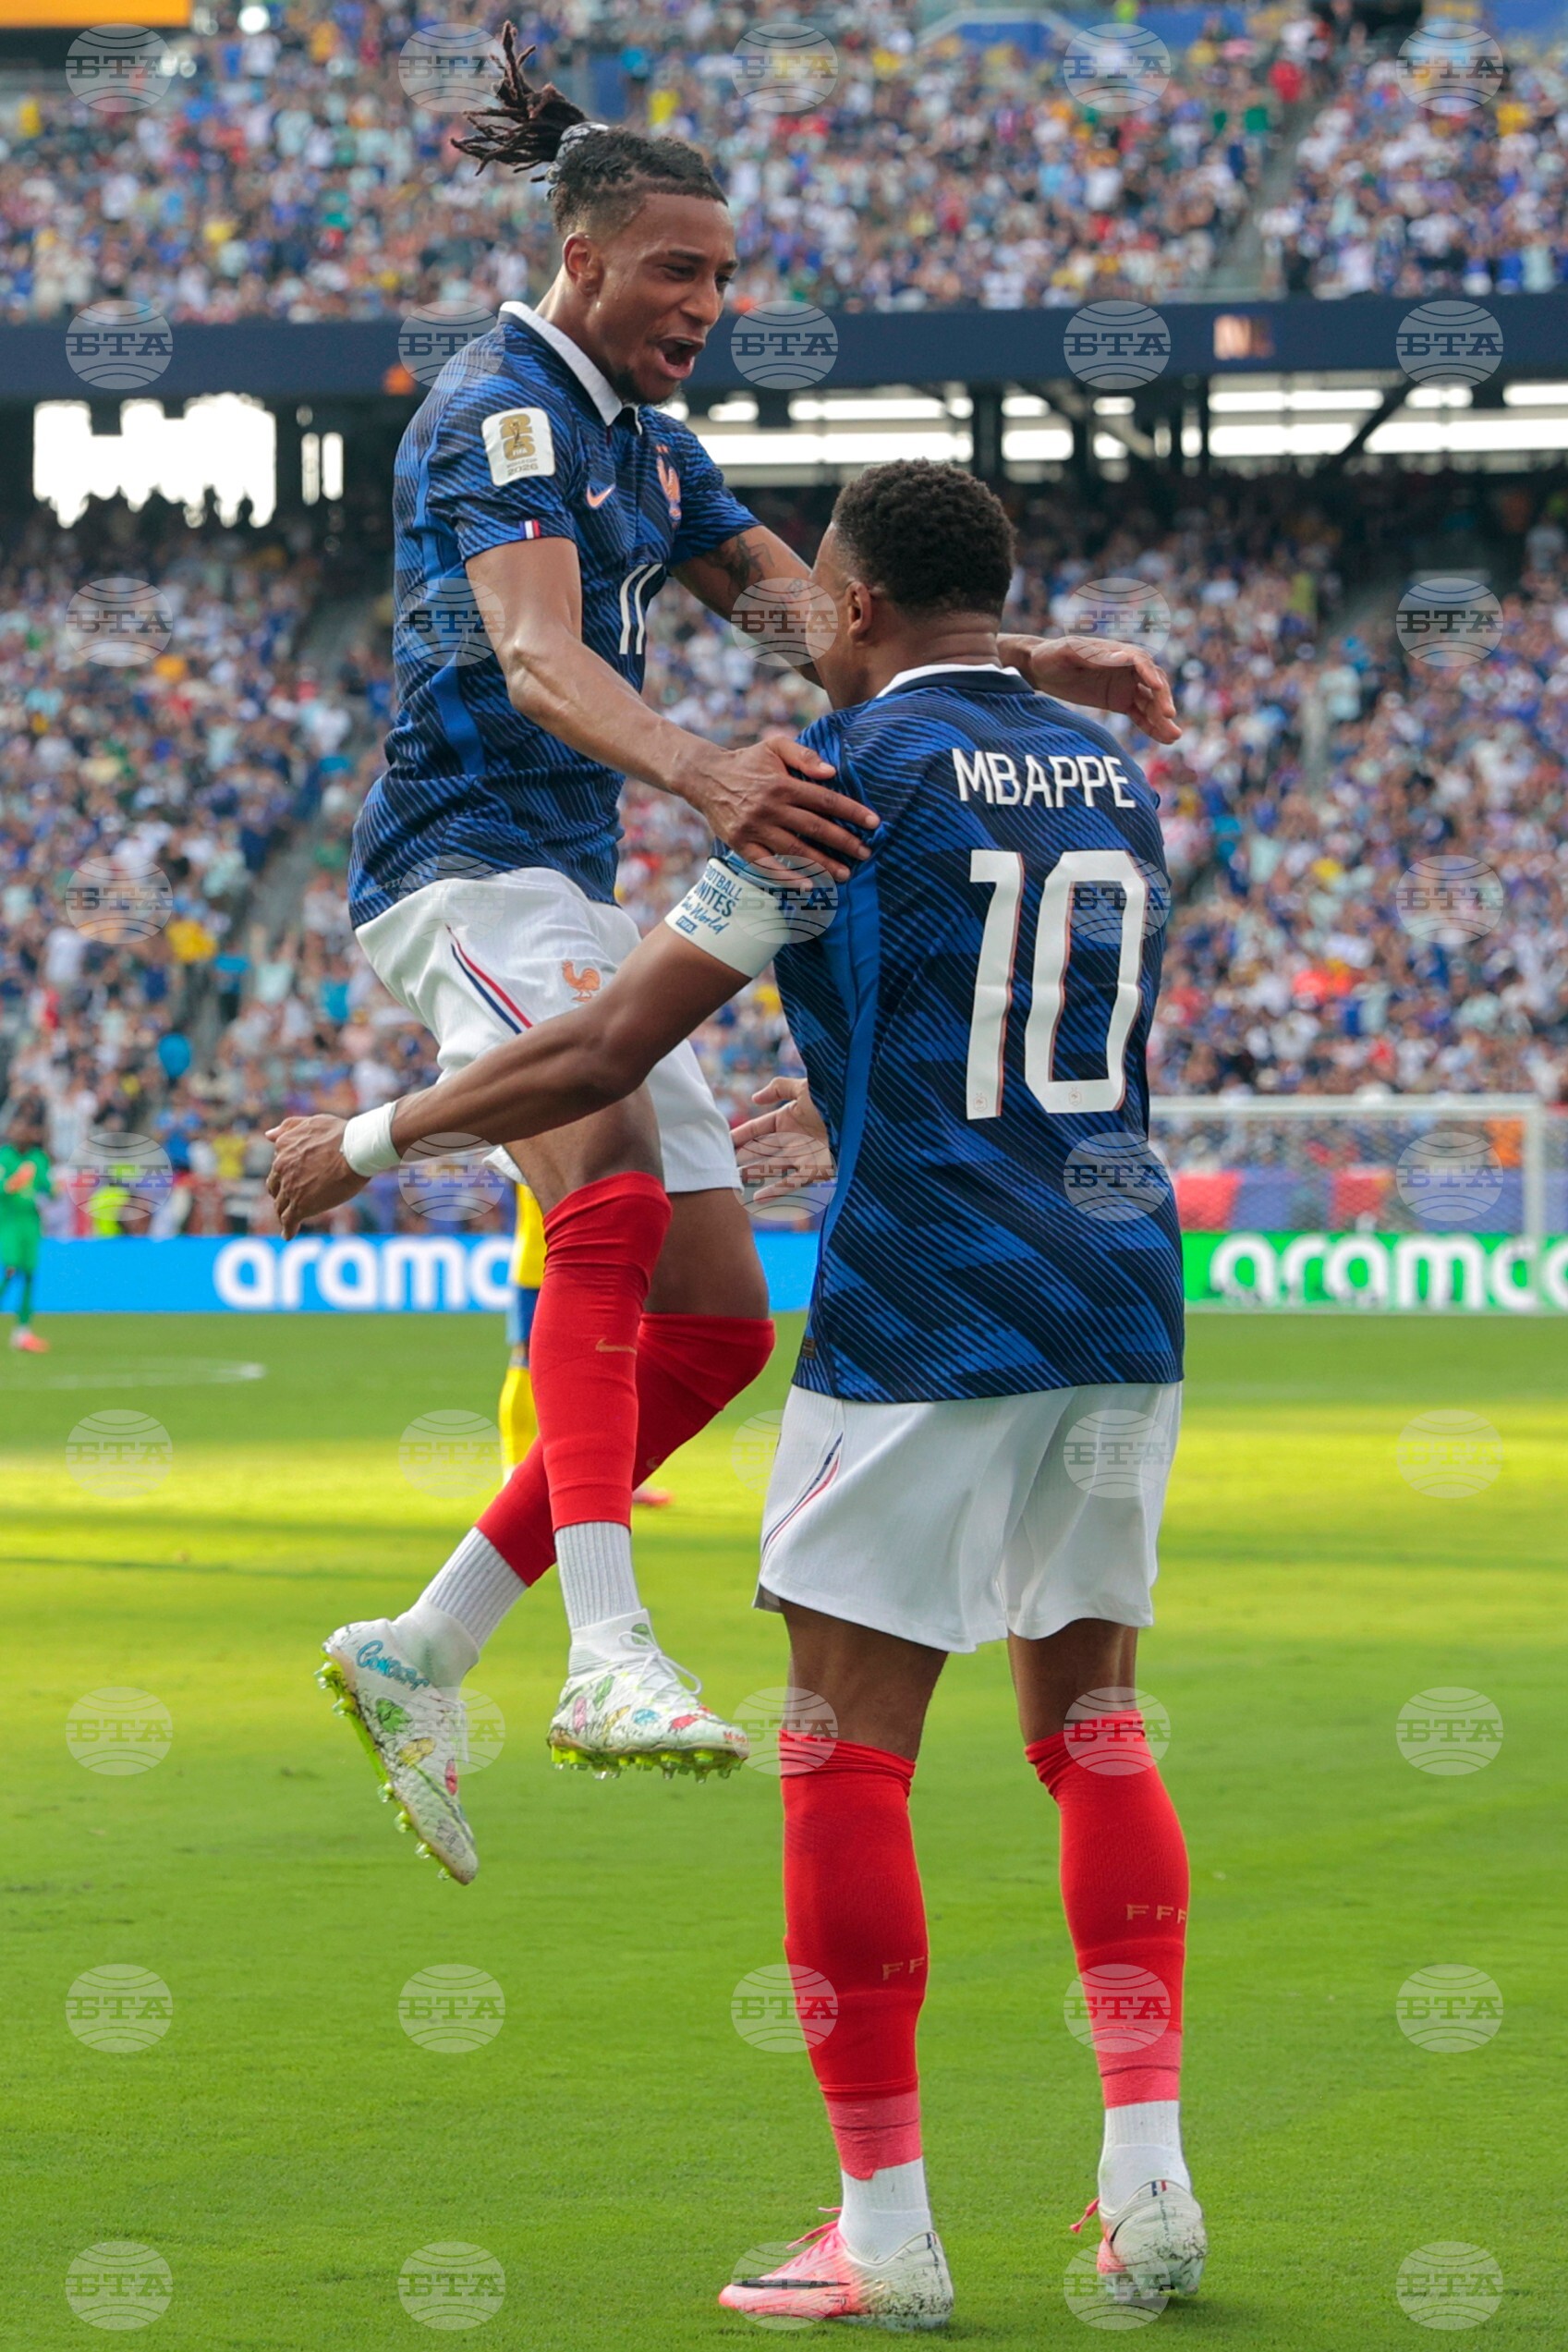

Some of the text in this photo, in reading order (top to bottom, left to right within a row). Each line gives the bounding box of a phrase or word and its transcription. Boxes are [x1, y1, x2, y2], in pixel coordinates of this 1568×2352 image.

[619, 563, 663, 655] 11
[952, 748, 1136, 808] MBAPPE
[689, 902, 730, 935] World
[966, 849, 1149, 1120] 10
[212, 1236, 516, 1310] aramc
